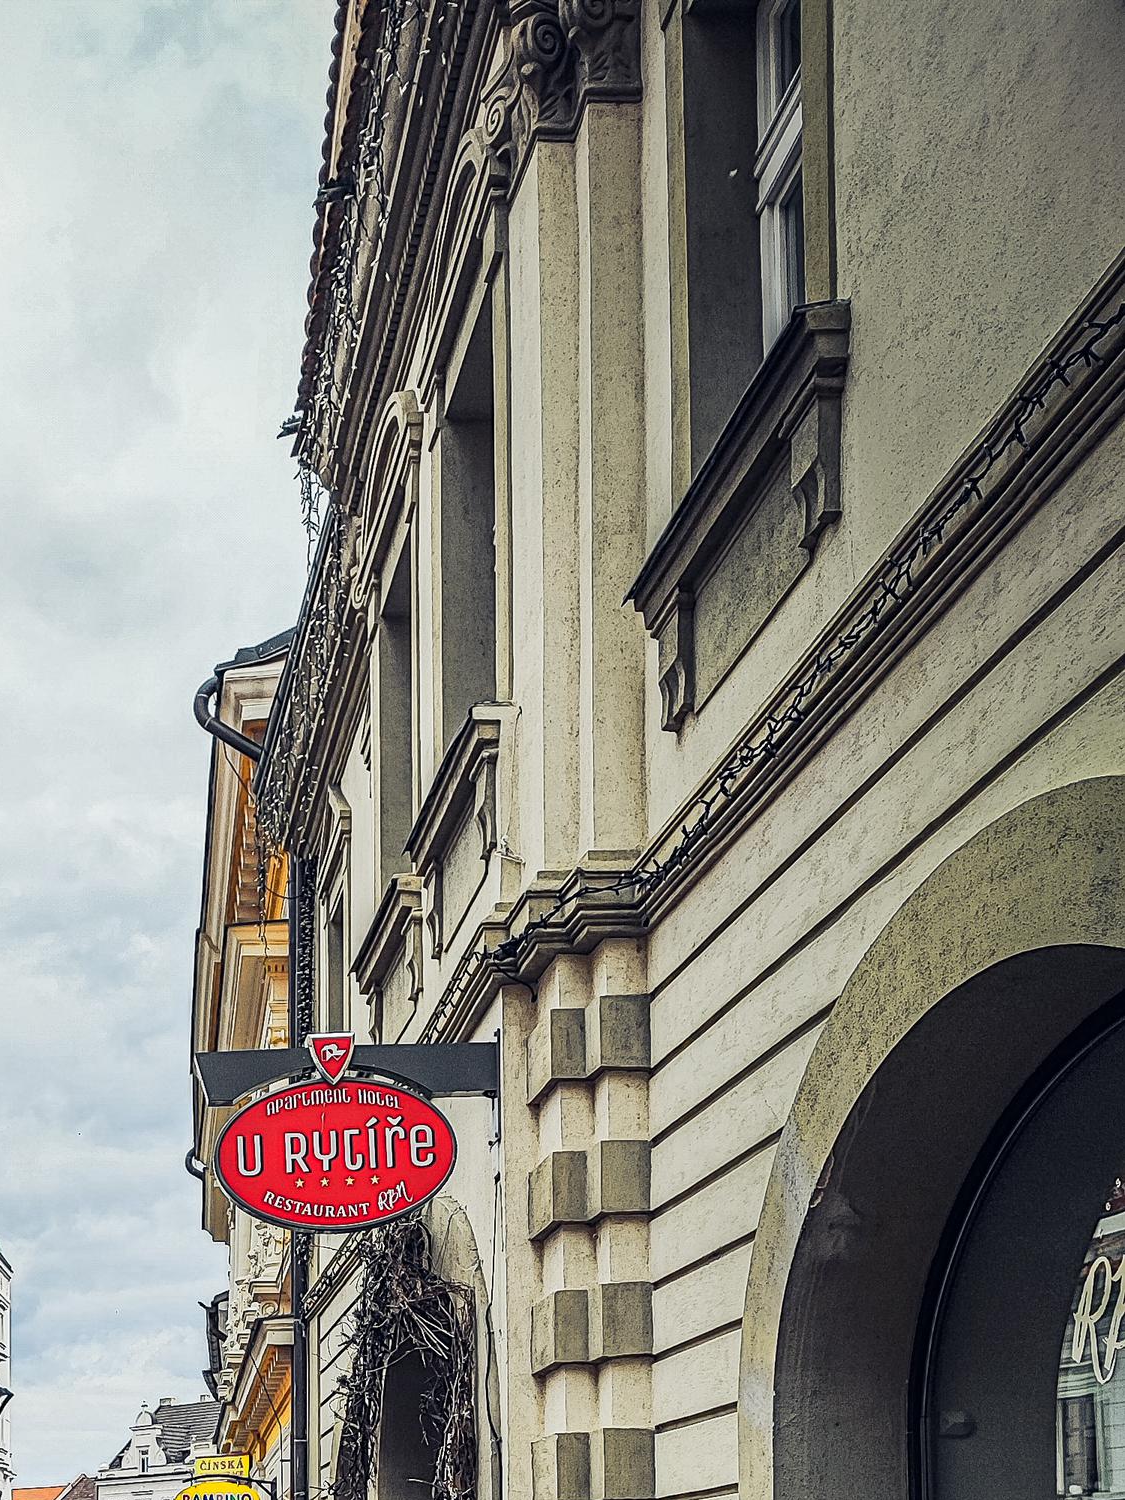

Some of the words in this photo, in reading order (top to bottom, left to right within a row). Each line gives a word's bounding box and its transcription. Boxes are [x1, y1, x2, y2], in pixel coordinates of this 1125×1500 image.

[237, 1134, 262, 1177] U
[263, 1190, 370, 1218] RESTAURANT
[200, 1457, 244, 1471] ČÍNSKÁ
